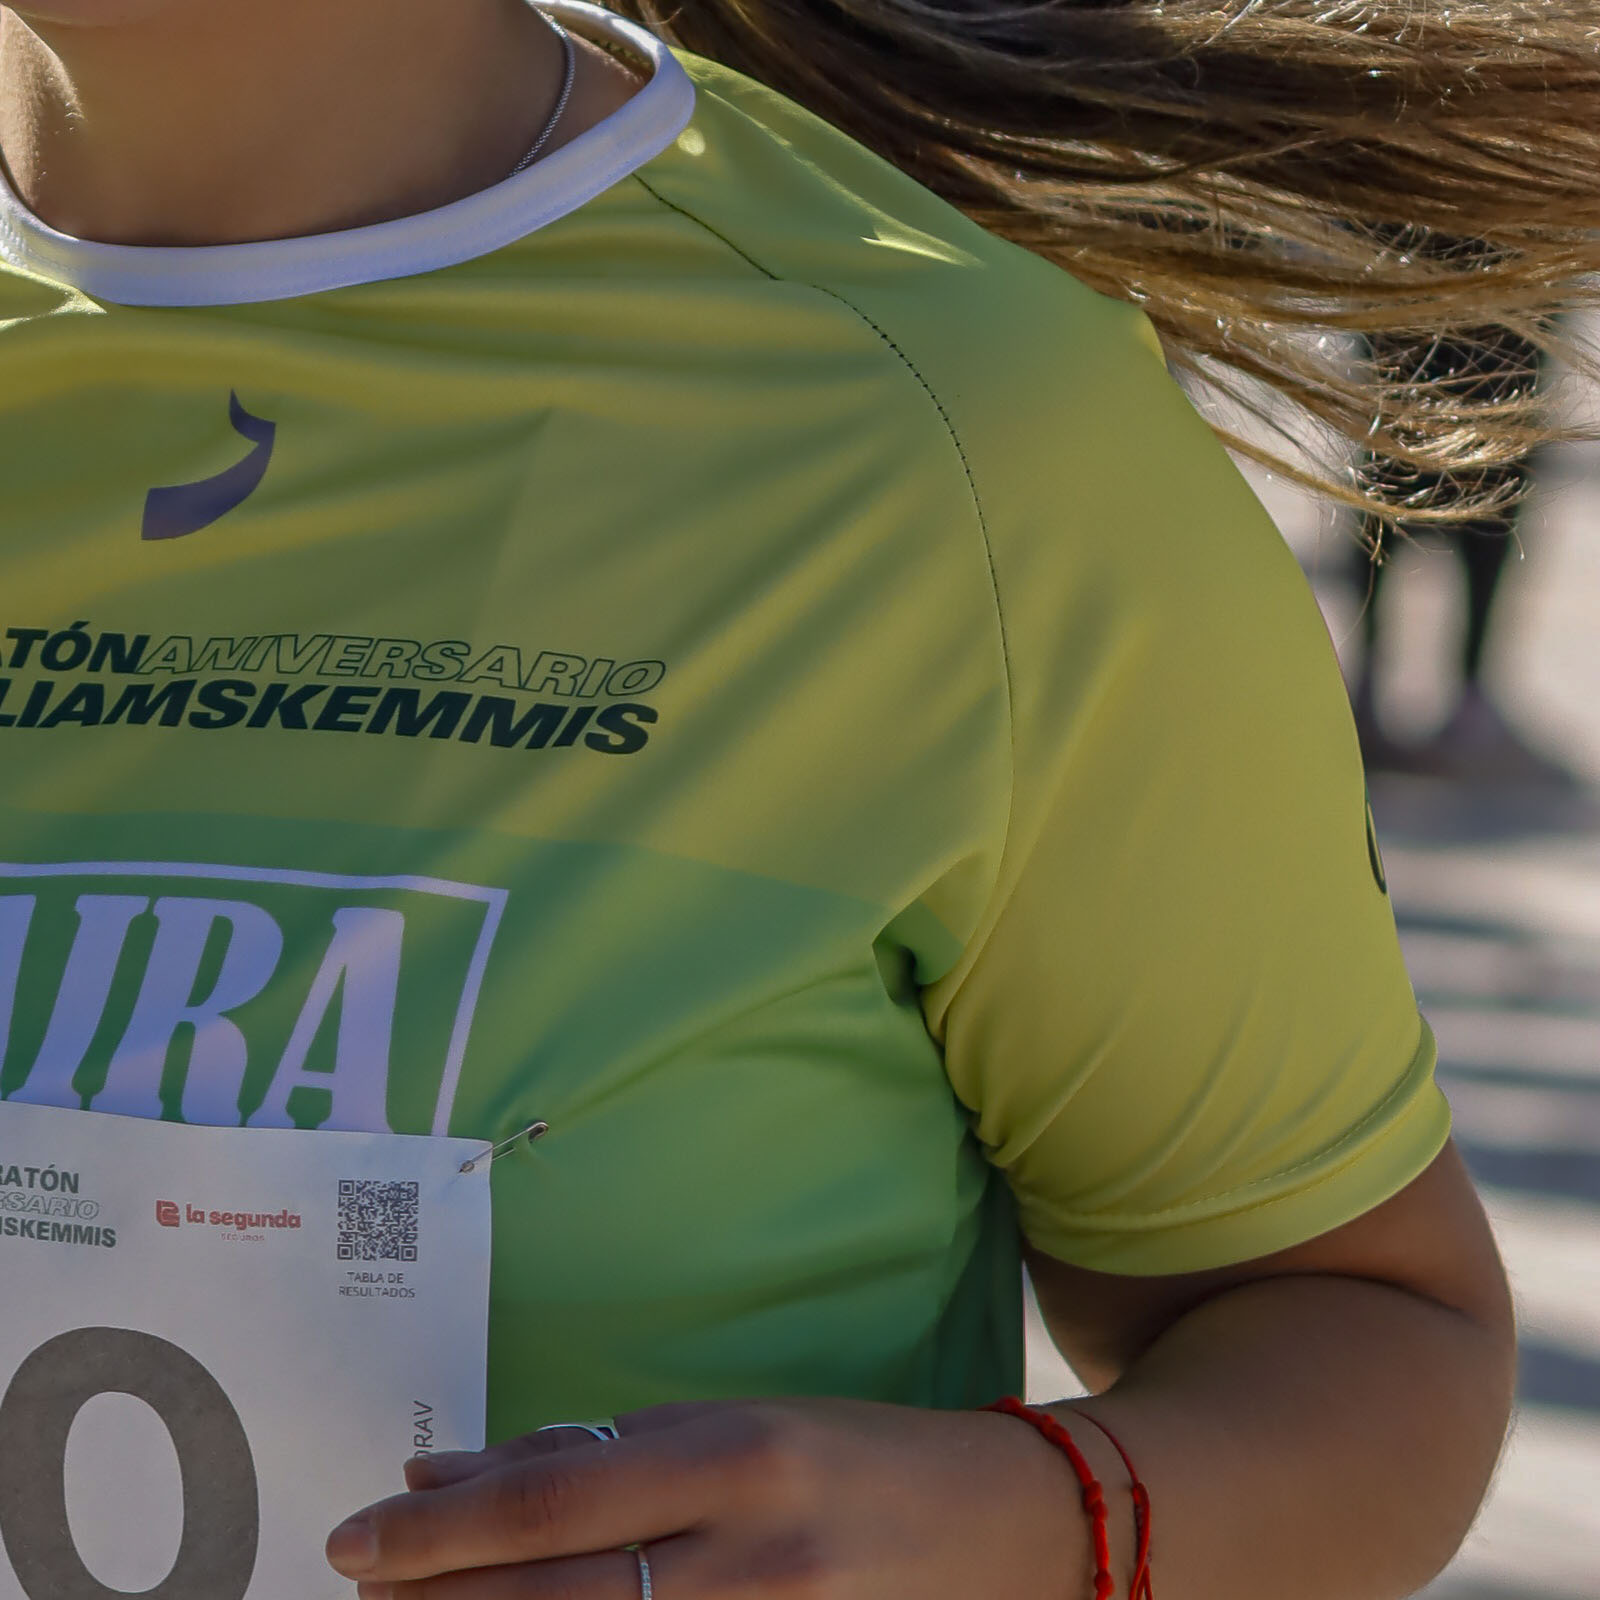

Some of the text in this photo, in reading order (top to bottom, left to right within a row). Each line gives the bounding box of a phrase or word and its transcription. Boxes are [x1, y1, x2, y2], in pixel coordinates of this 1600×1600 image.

[186, 1203, 302, 1231] la segunda
[347, 1271, 405, 1285] TABLA DE
[338, 1285, 416, 1299] RESULTADOS
